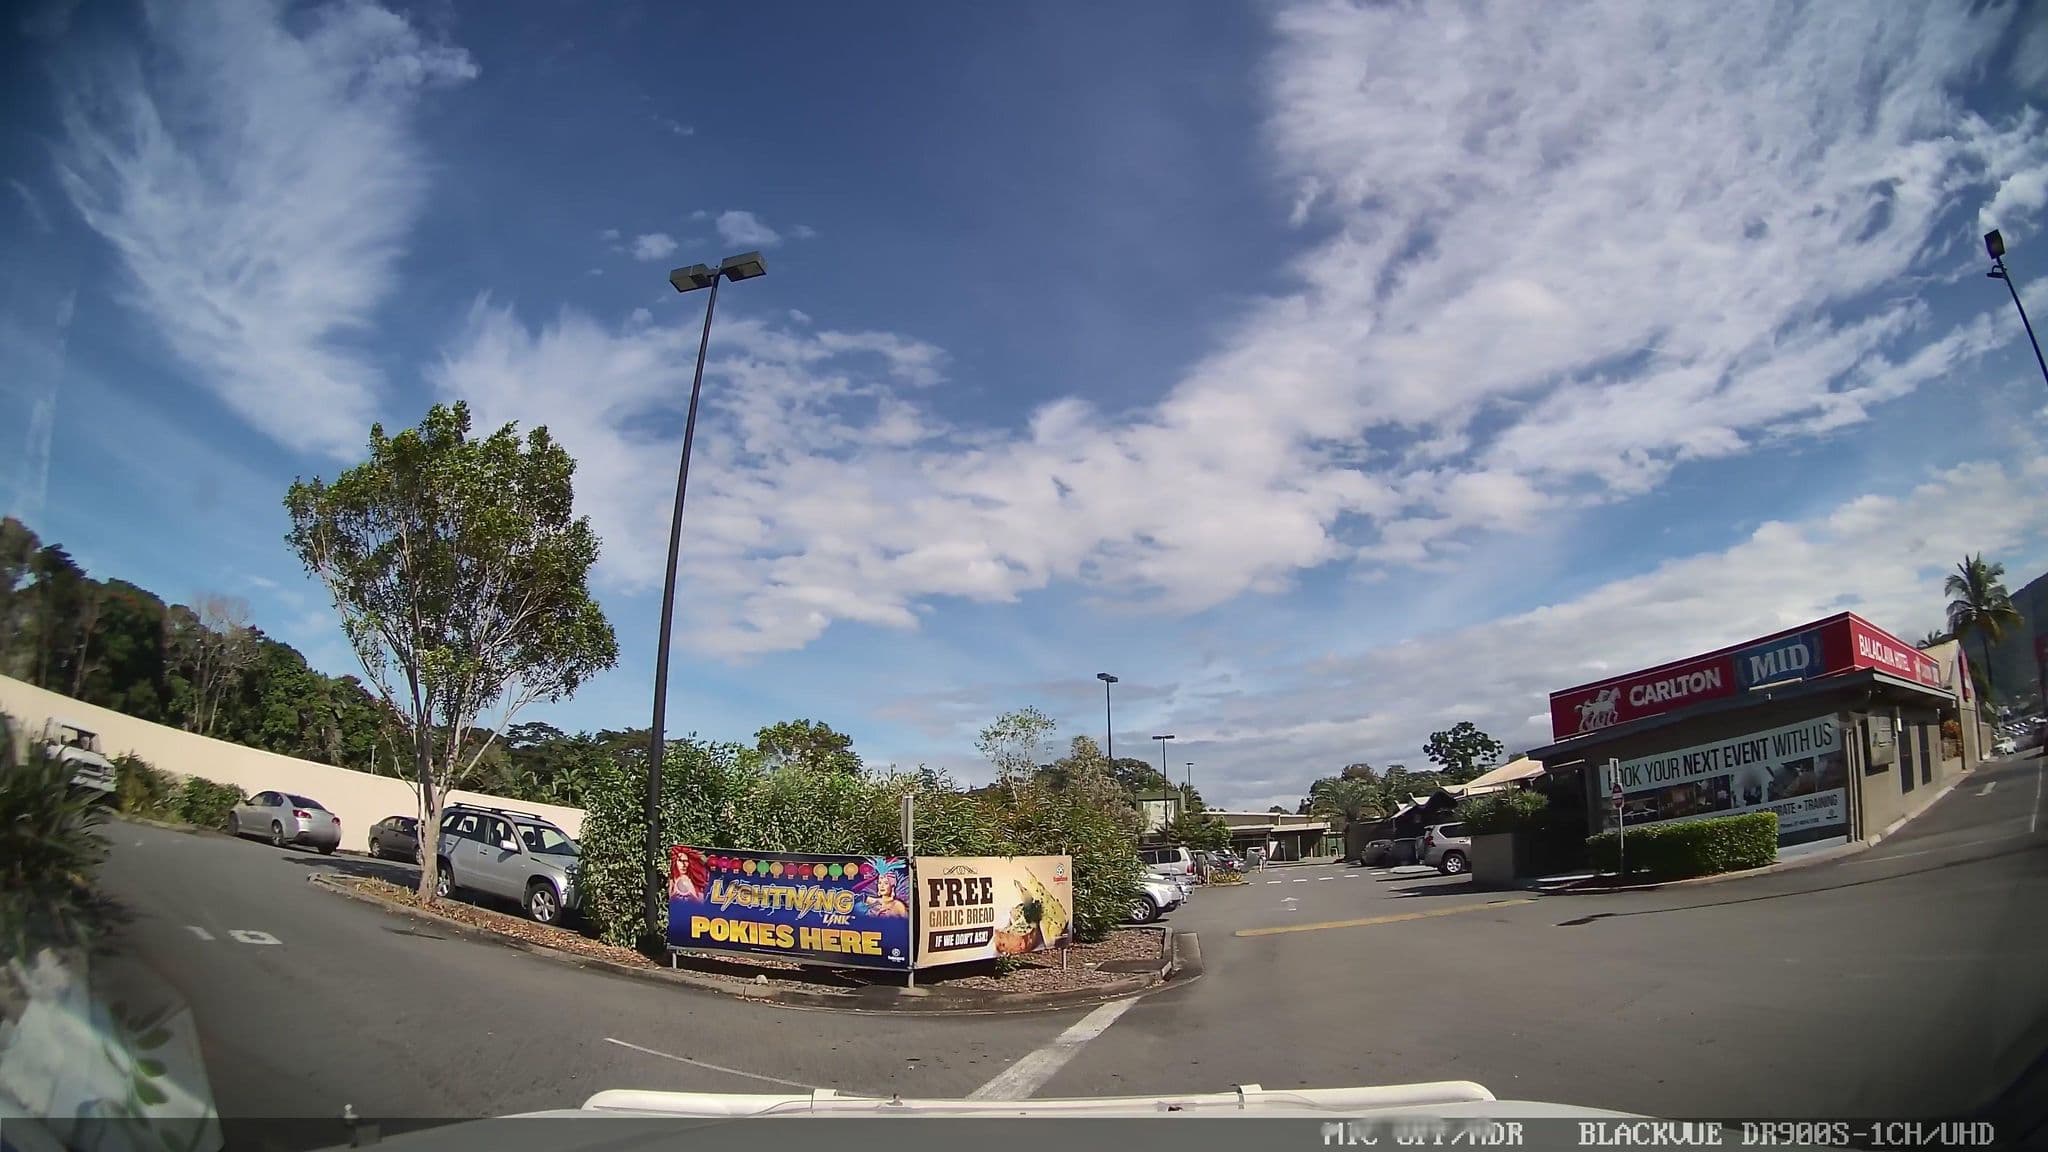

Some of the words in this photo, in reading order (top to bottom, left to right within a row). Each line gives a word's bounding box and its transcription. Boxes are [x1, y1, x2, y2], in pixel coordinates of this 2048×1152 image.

[1749, 643, 1810, 684] MID
[1628, 667, 1722, 708] CARLTON
[1608, 764, 1642, 790] OOK
[1644, 757, 1680, 783] YOUR
[1682, 748, 1719, 776] NEXT
[1723, 737, 1768, 768] EVENT
[1772, 727, 1811, 758] WITH
[1813, 722, 1832, 748] US
[1803, 794, 1838, 811] TRAINING
[710, 879, 855, 920] LIGHTNING
[927, 877, 993, 908] FREE
[691, 915, 795, 949] POKIES
[799, 926, 882, 955] HERE
[929, 909, 964, 928] GARLIC
[966, 906, 995, 925] BREAD
[935, 936, 943, 948] IF
[943, 934, 954, 947] WE
[955, 932, 973, 946] DON'T
